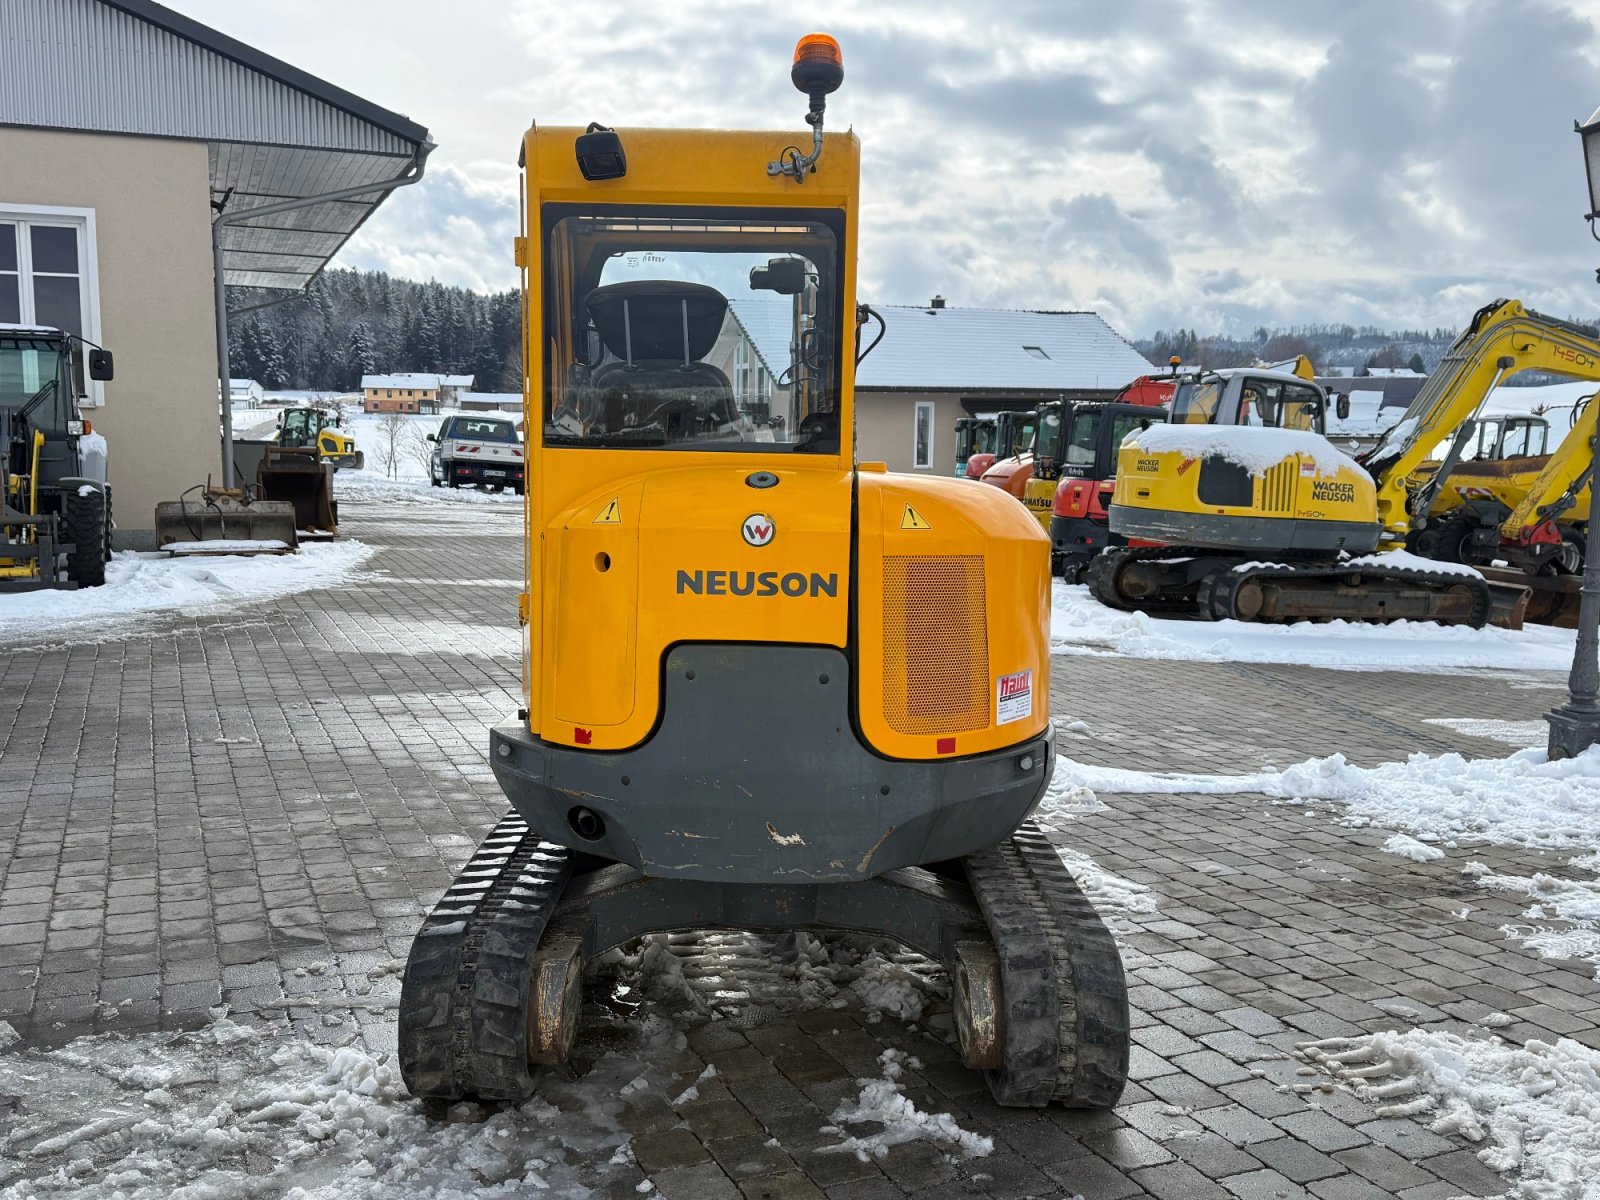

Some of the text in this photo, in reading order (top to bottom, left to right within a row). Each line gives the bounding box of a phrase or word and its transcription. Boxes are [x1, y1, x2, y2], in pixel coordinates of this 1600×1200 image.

[1553, 345, 1596, 369] 14504
[1312, 481, 1355, 492] WACKER
[1024, 496, 1052, 508] MATSU
[1312, 490, 1355, 503] NEUSON
[1297, 509, 1326, 518] 14504
[676, 569, 838, 598] NEUSON
